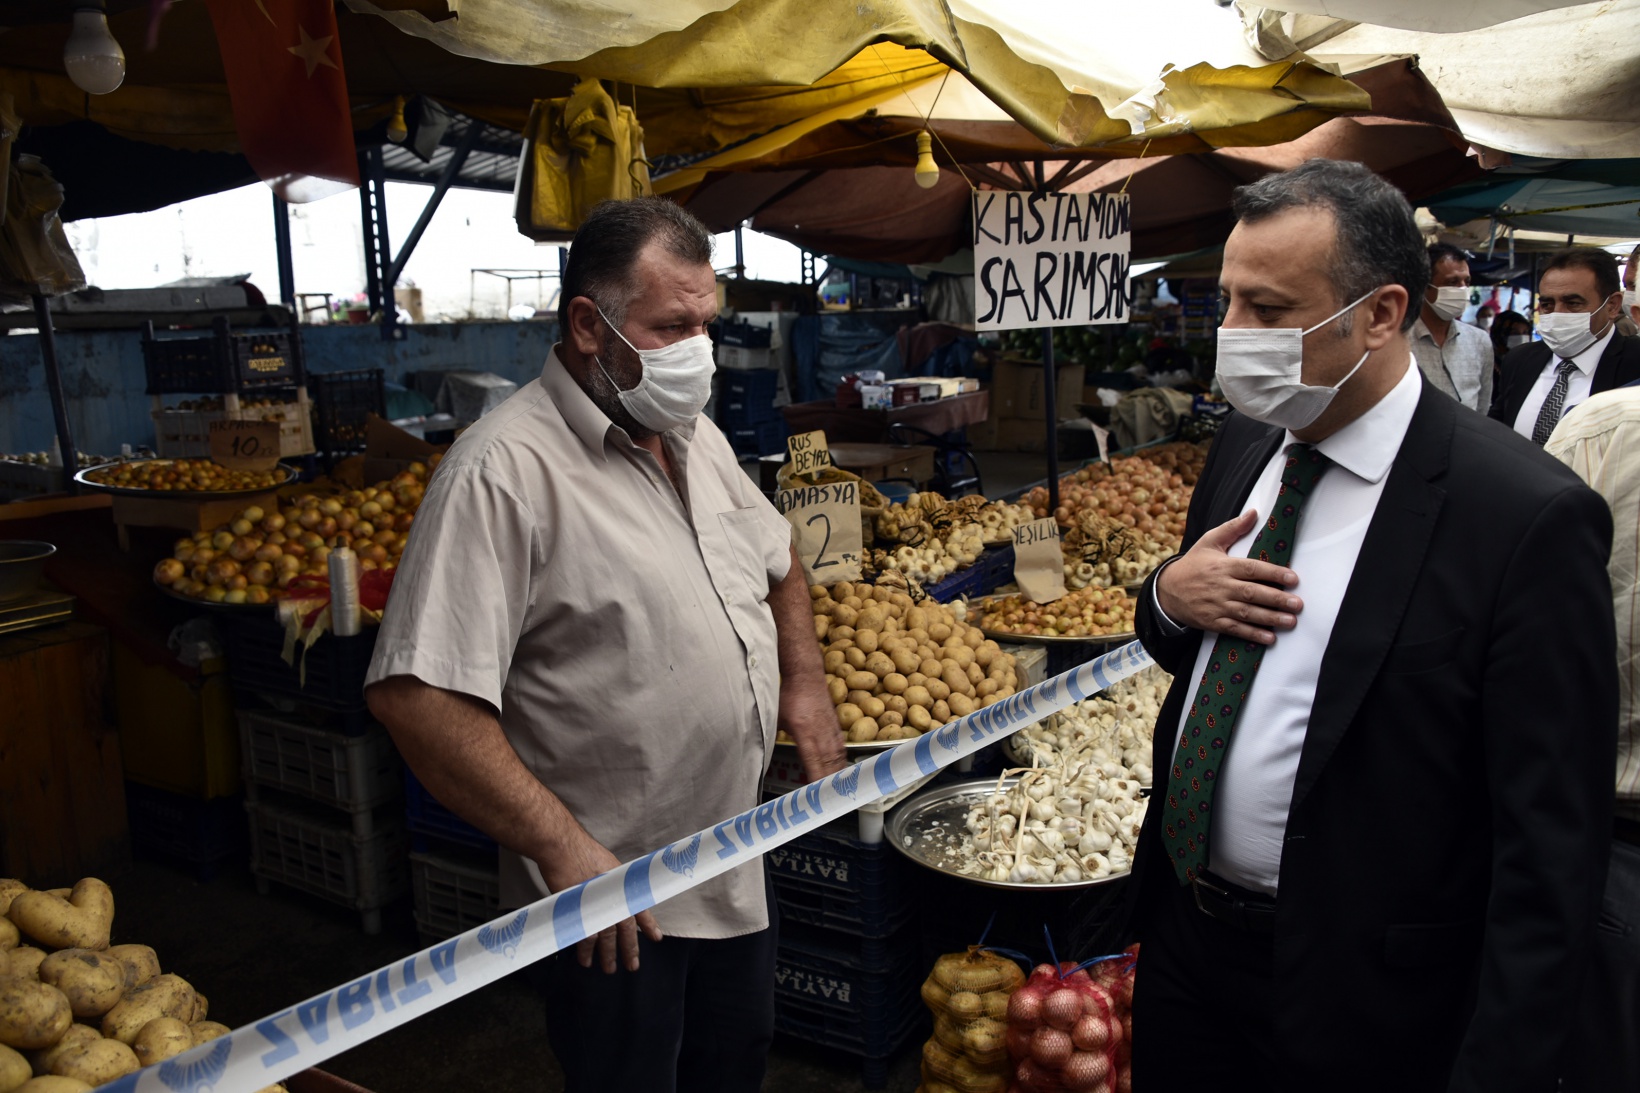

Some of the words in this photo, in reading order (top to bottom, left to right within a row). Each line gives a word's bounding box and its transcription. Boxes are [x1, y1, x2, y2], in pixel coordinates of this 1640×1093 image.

[976, 251, 1132, 324] SARIMSAK
[232, 436, 260, 456] 10
[789, 433, 812, 452] RUS
[795, 448, 829, 473] BEYAZ
[779, 482, 855, 515] AMASYA
[806, 513, 840, 570] 2
